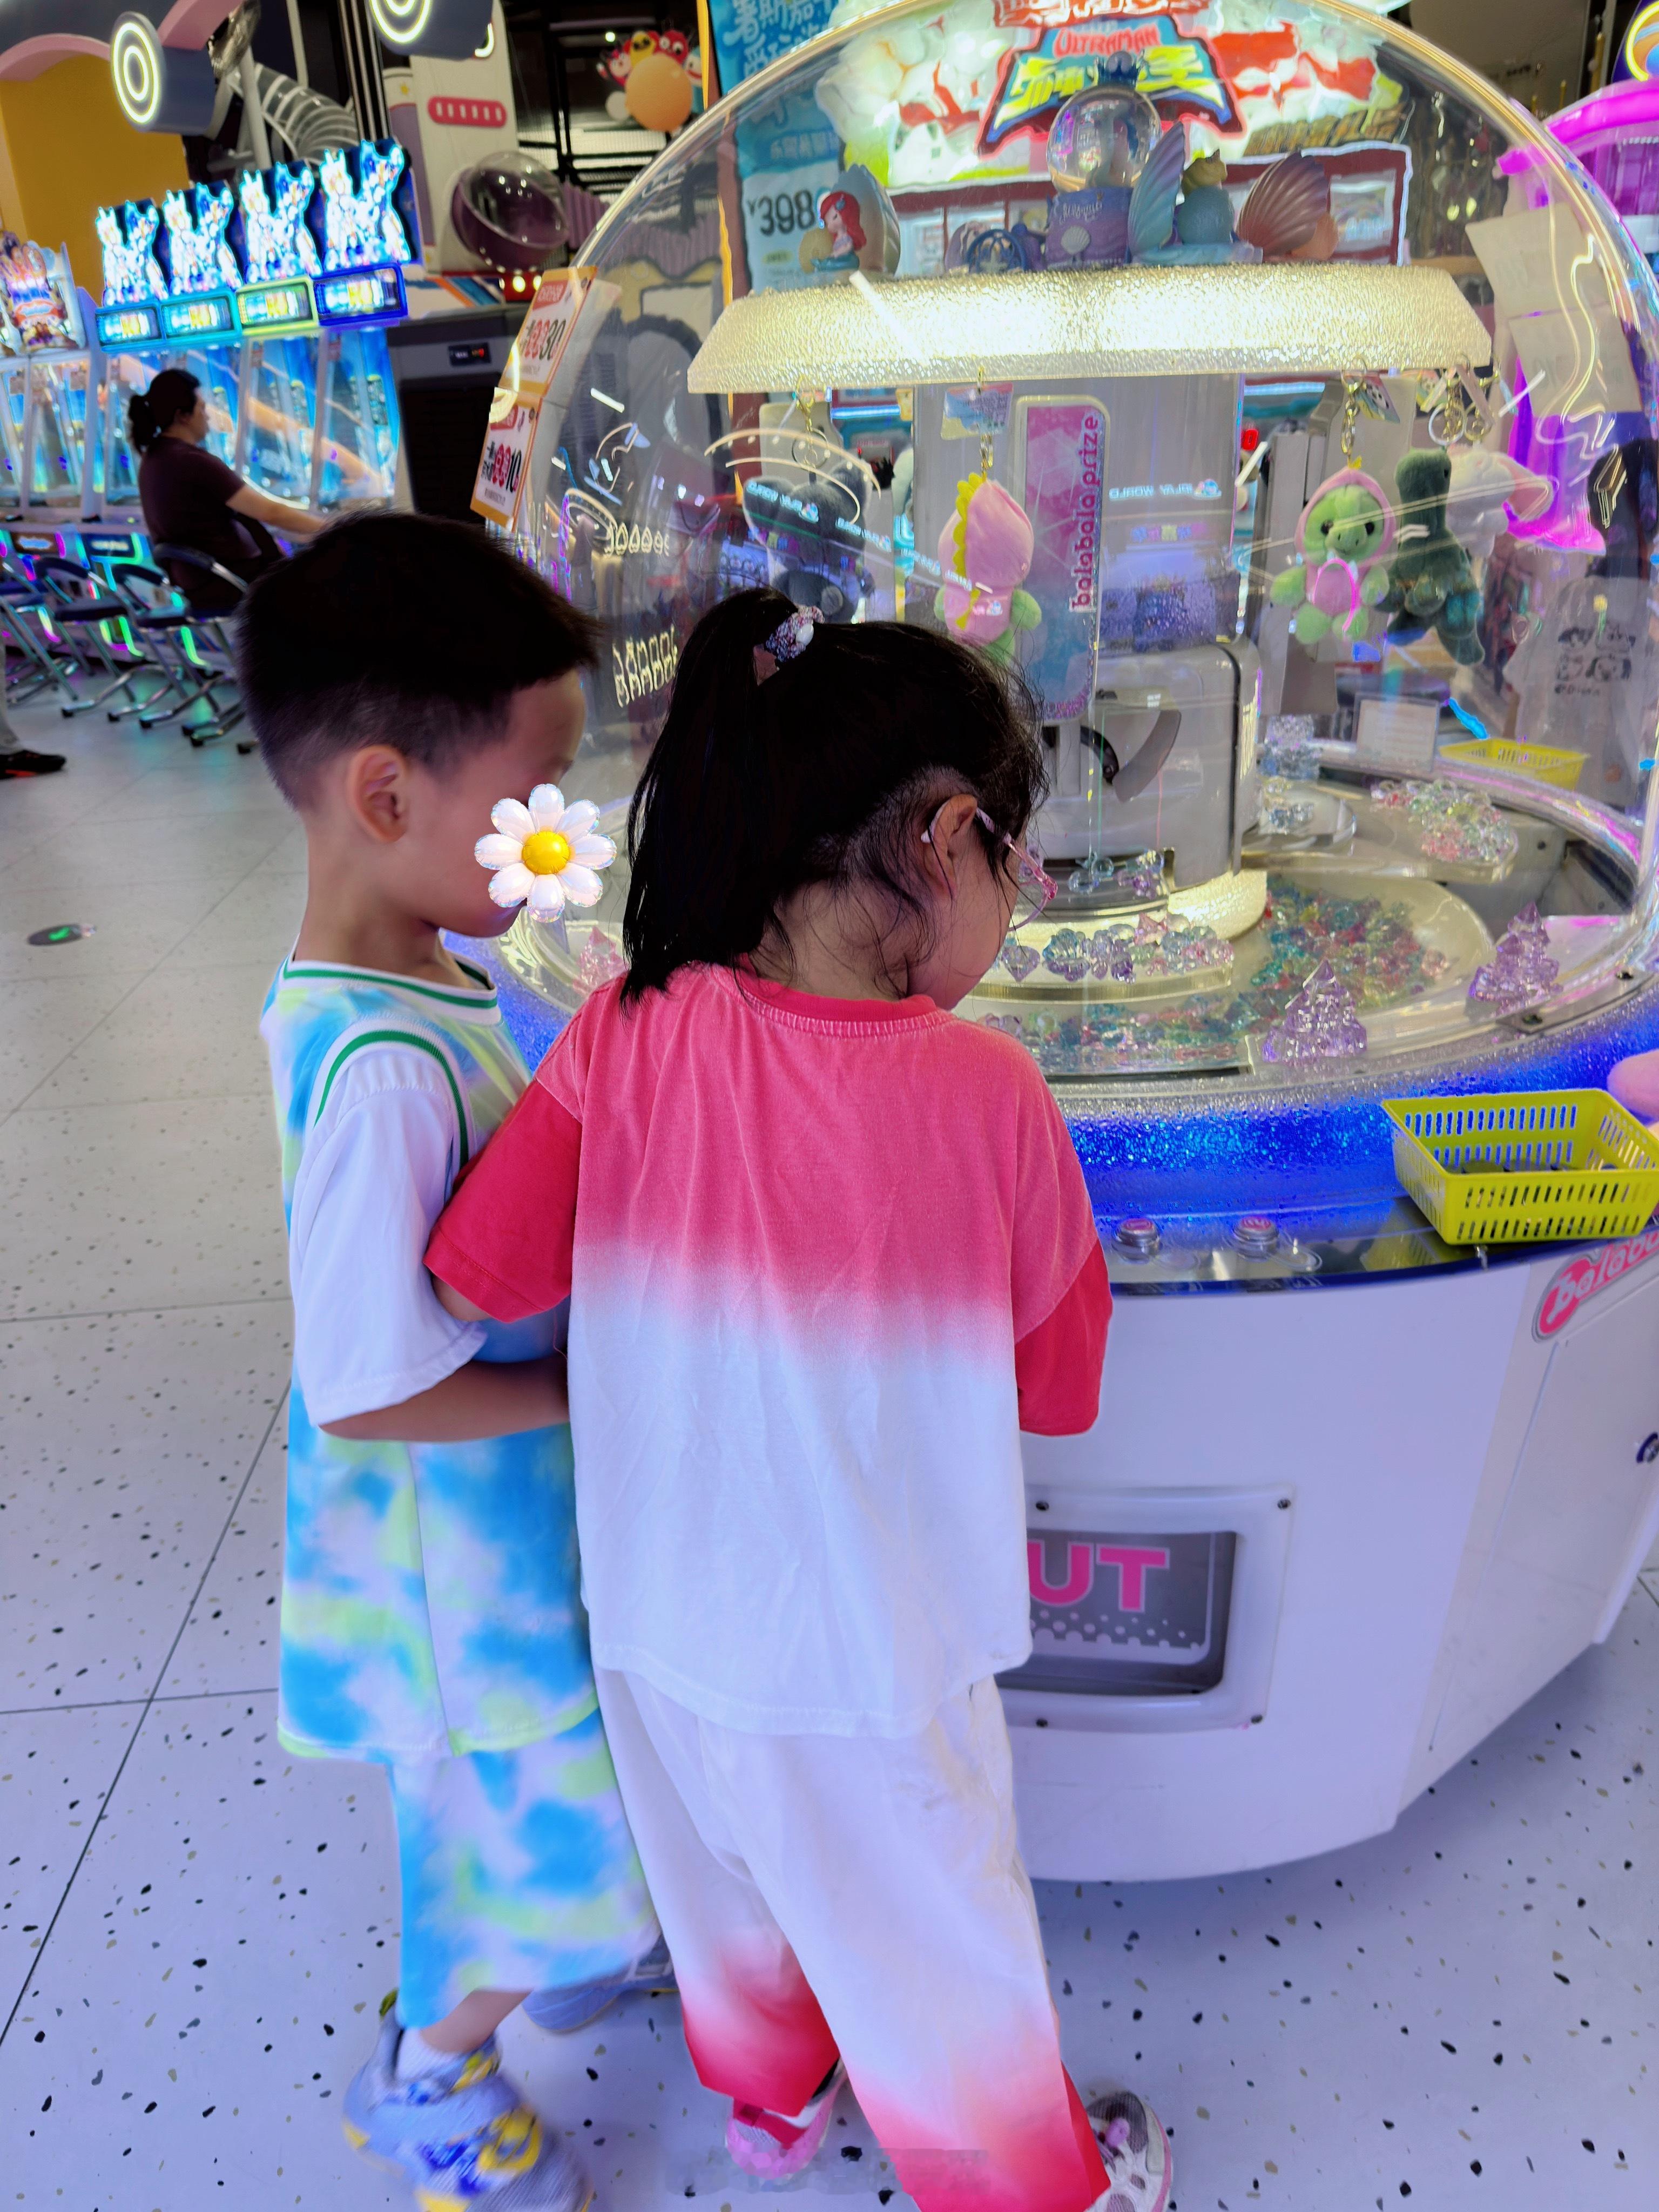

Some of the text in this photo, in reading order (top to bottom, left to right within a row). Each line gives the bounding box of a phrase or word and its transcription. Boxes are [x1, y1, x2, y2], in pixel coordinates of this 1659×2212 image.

[1053, 23, 1162, 58] ULTRAMAN
[1071, 415, 1101, 611] balabala prize
